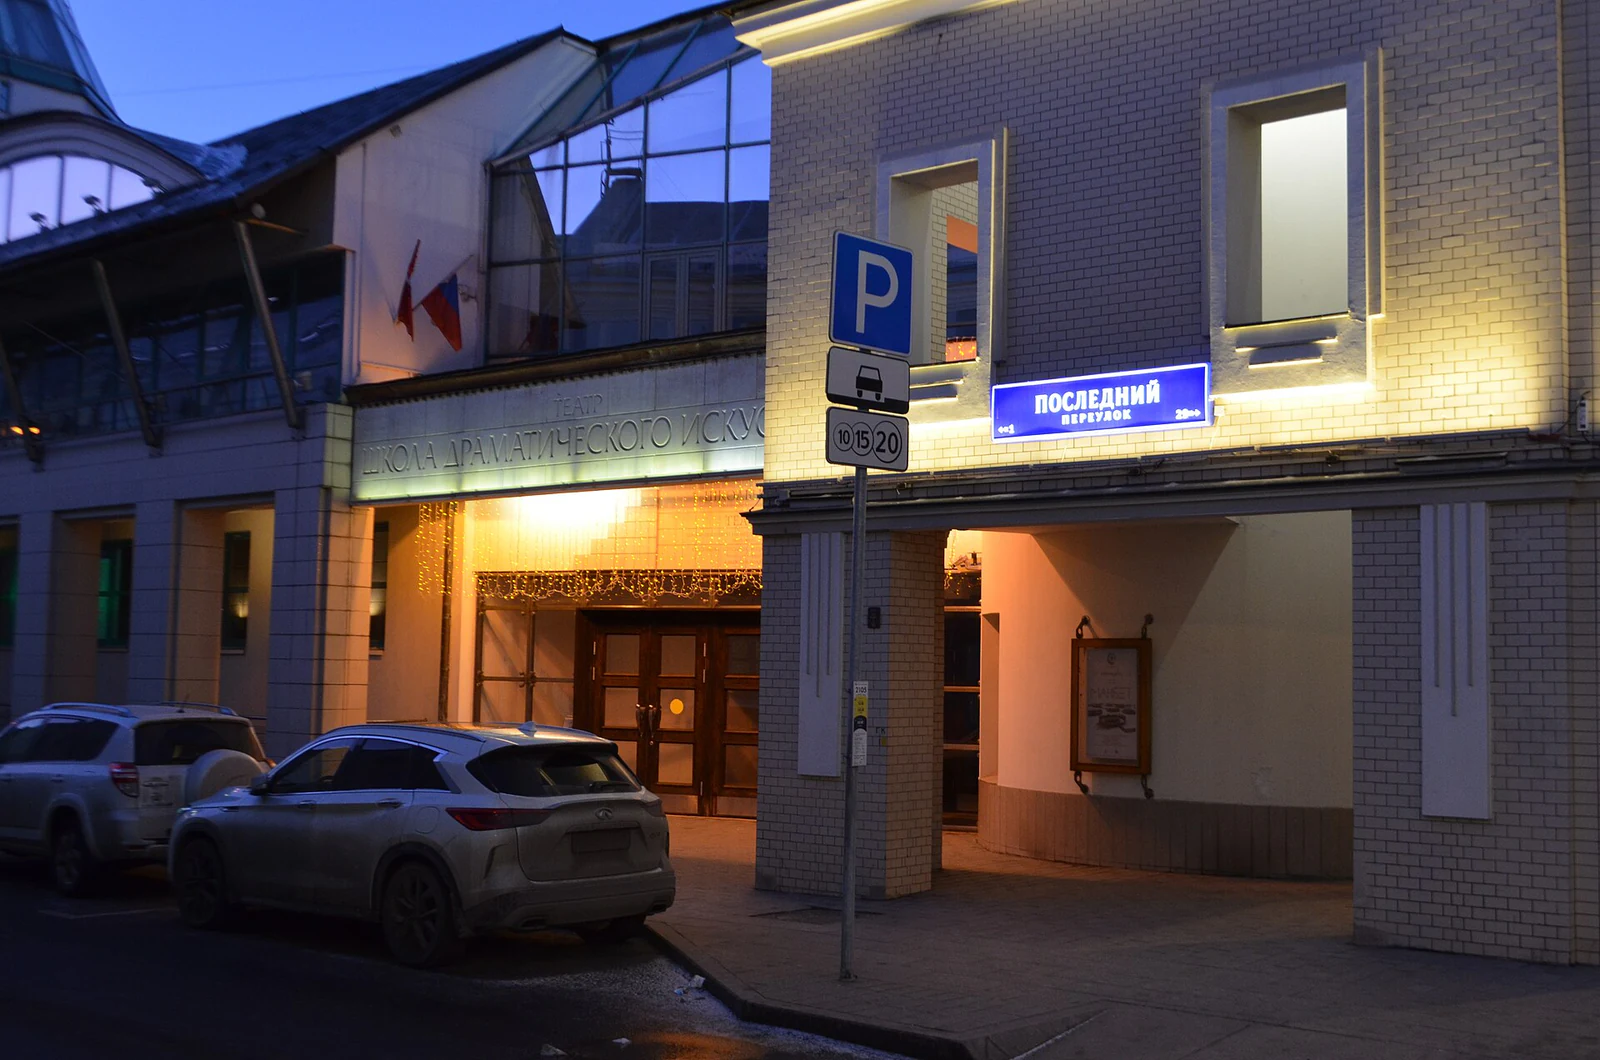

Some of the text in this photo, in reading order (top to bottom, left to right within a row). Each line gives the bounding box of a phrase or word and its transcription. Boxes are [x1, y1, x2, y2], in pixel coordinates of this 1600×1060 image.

[855, 249, 899, 334] P
[553, 393, 603, 418] ТЕАТР
[1034, 379, 1161, 415] ПОСЛЕДНИЙ
[1061, 409, 1132, 425] ПЕРЕУЛОК
[362, 440, 436, 475] ШКОЛА
[443, 416, 673, 468] ДРАМАТИЧЕСКОГО
[837, 428, 898, 455] 10 15 20
